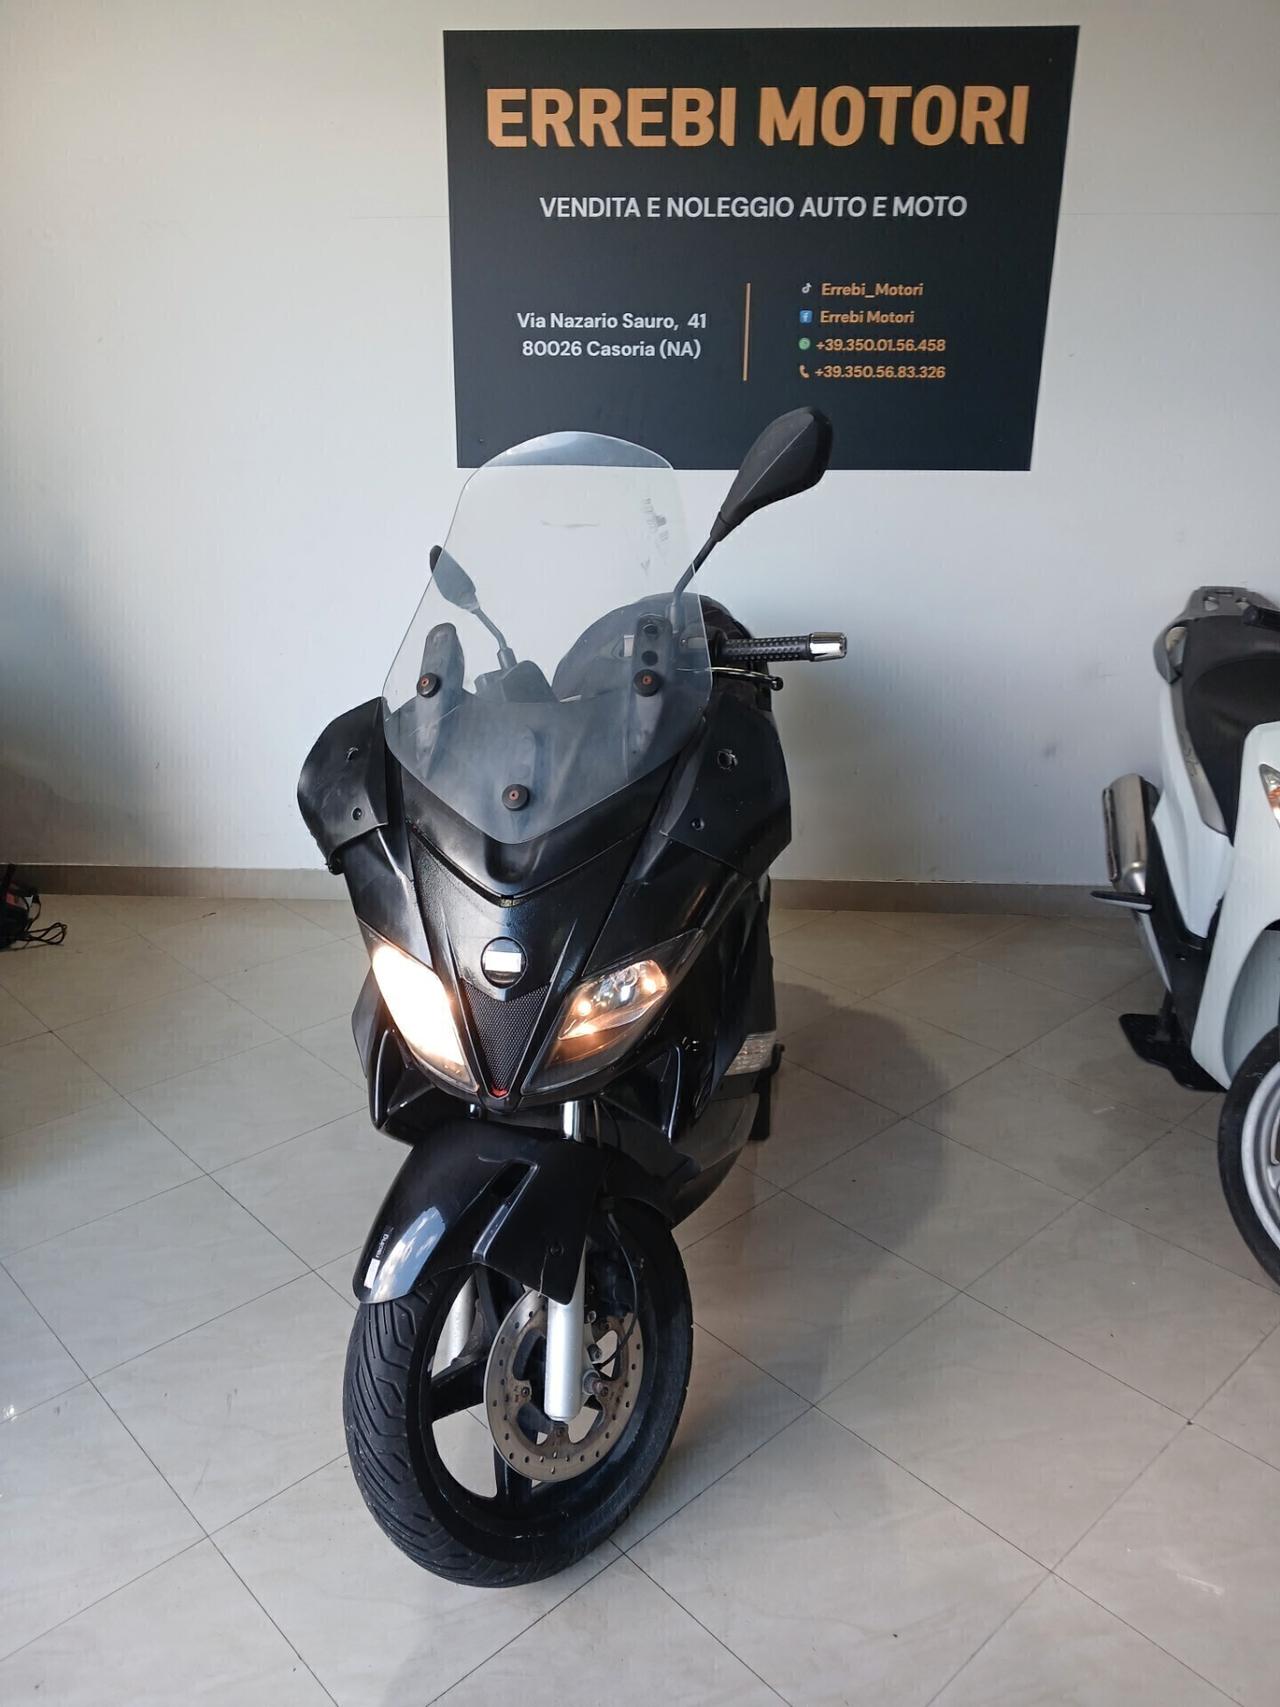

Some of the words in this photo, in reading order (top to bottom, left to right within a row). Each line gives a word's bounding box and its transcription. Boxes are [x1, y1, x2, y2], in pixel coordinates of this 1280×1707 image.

[487, 87, 737, 148] ERREBI
[758, 84, 1030, 147] MOTORI
[539, 196, 642, 218] VENDITA
[647, 196, 662, 218] E
[667, 196, 795, 218] NOLEGGIO
[799, 195, 867, 218] AUTO
[873, 196, 888, 217] E
[893, 195, 969, 217] MOTO
[821, 282, 924, 299] Errebi_Motori
[516, 312, 546, 329] Via
[550, 312, 618, 329] Nazario
[622, 312, 679, 331] Sauro,
[687, 312, 707, 329] 41
[820, 310, 864, 324] Errebi
[866, 310, 915, 324] Motori
[522, 340, 583, 357] 80026
[587, 340, 656, 357] Casoria
[659, 338, 701, 360] (NA)
[815, 338, 946, 352] +39.350.01.56.458
[814, 365, 946, 379] +39.350.56.83.326
